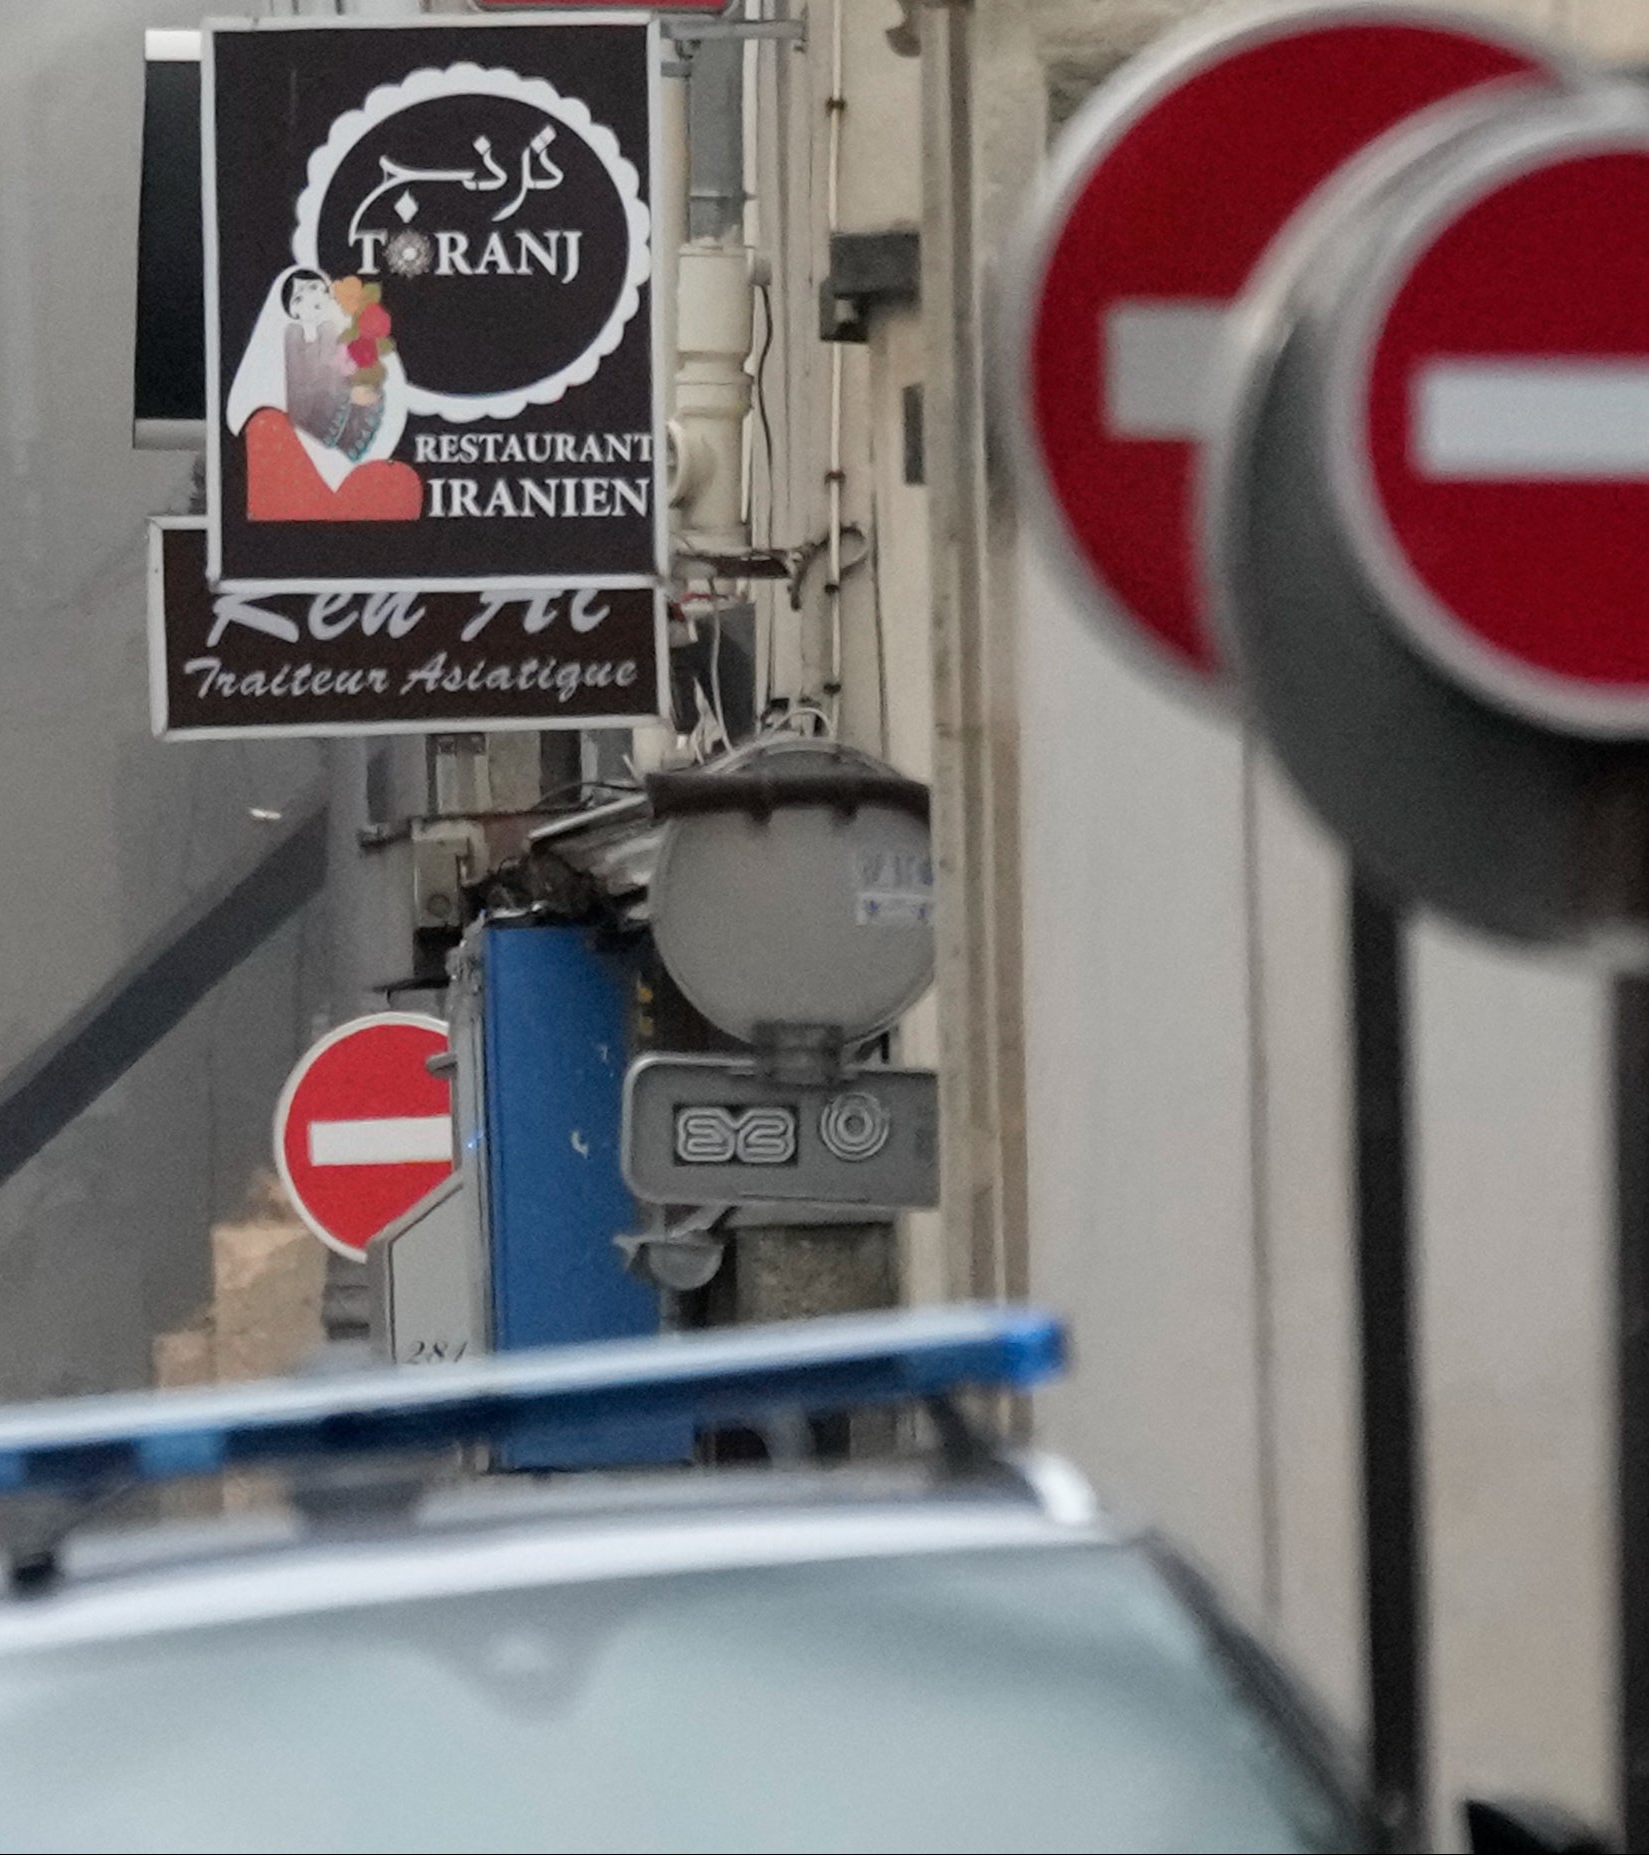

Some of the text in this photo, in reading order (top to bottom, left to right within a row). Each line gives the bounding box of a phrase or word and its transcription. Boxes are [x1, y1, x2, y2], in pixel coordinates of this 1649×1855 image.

[414, 432, 654, 464] RESTAURANT
[426, 476, 652, 518] IRANIEN
[185, 651, 638, 704] Traiteur Asiatique
